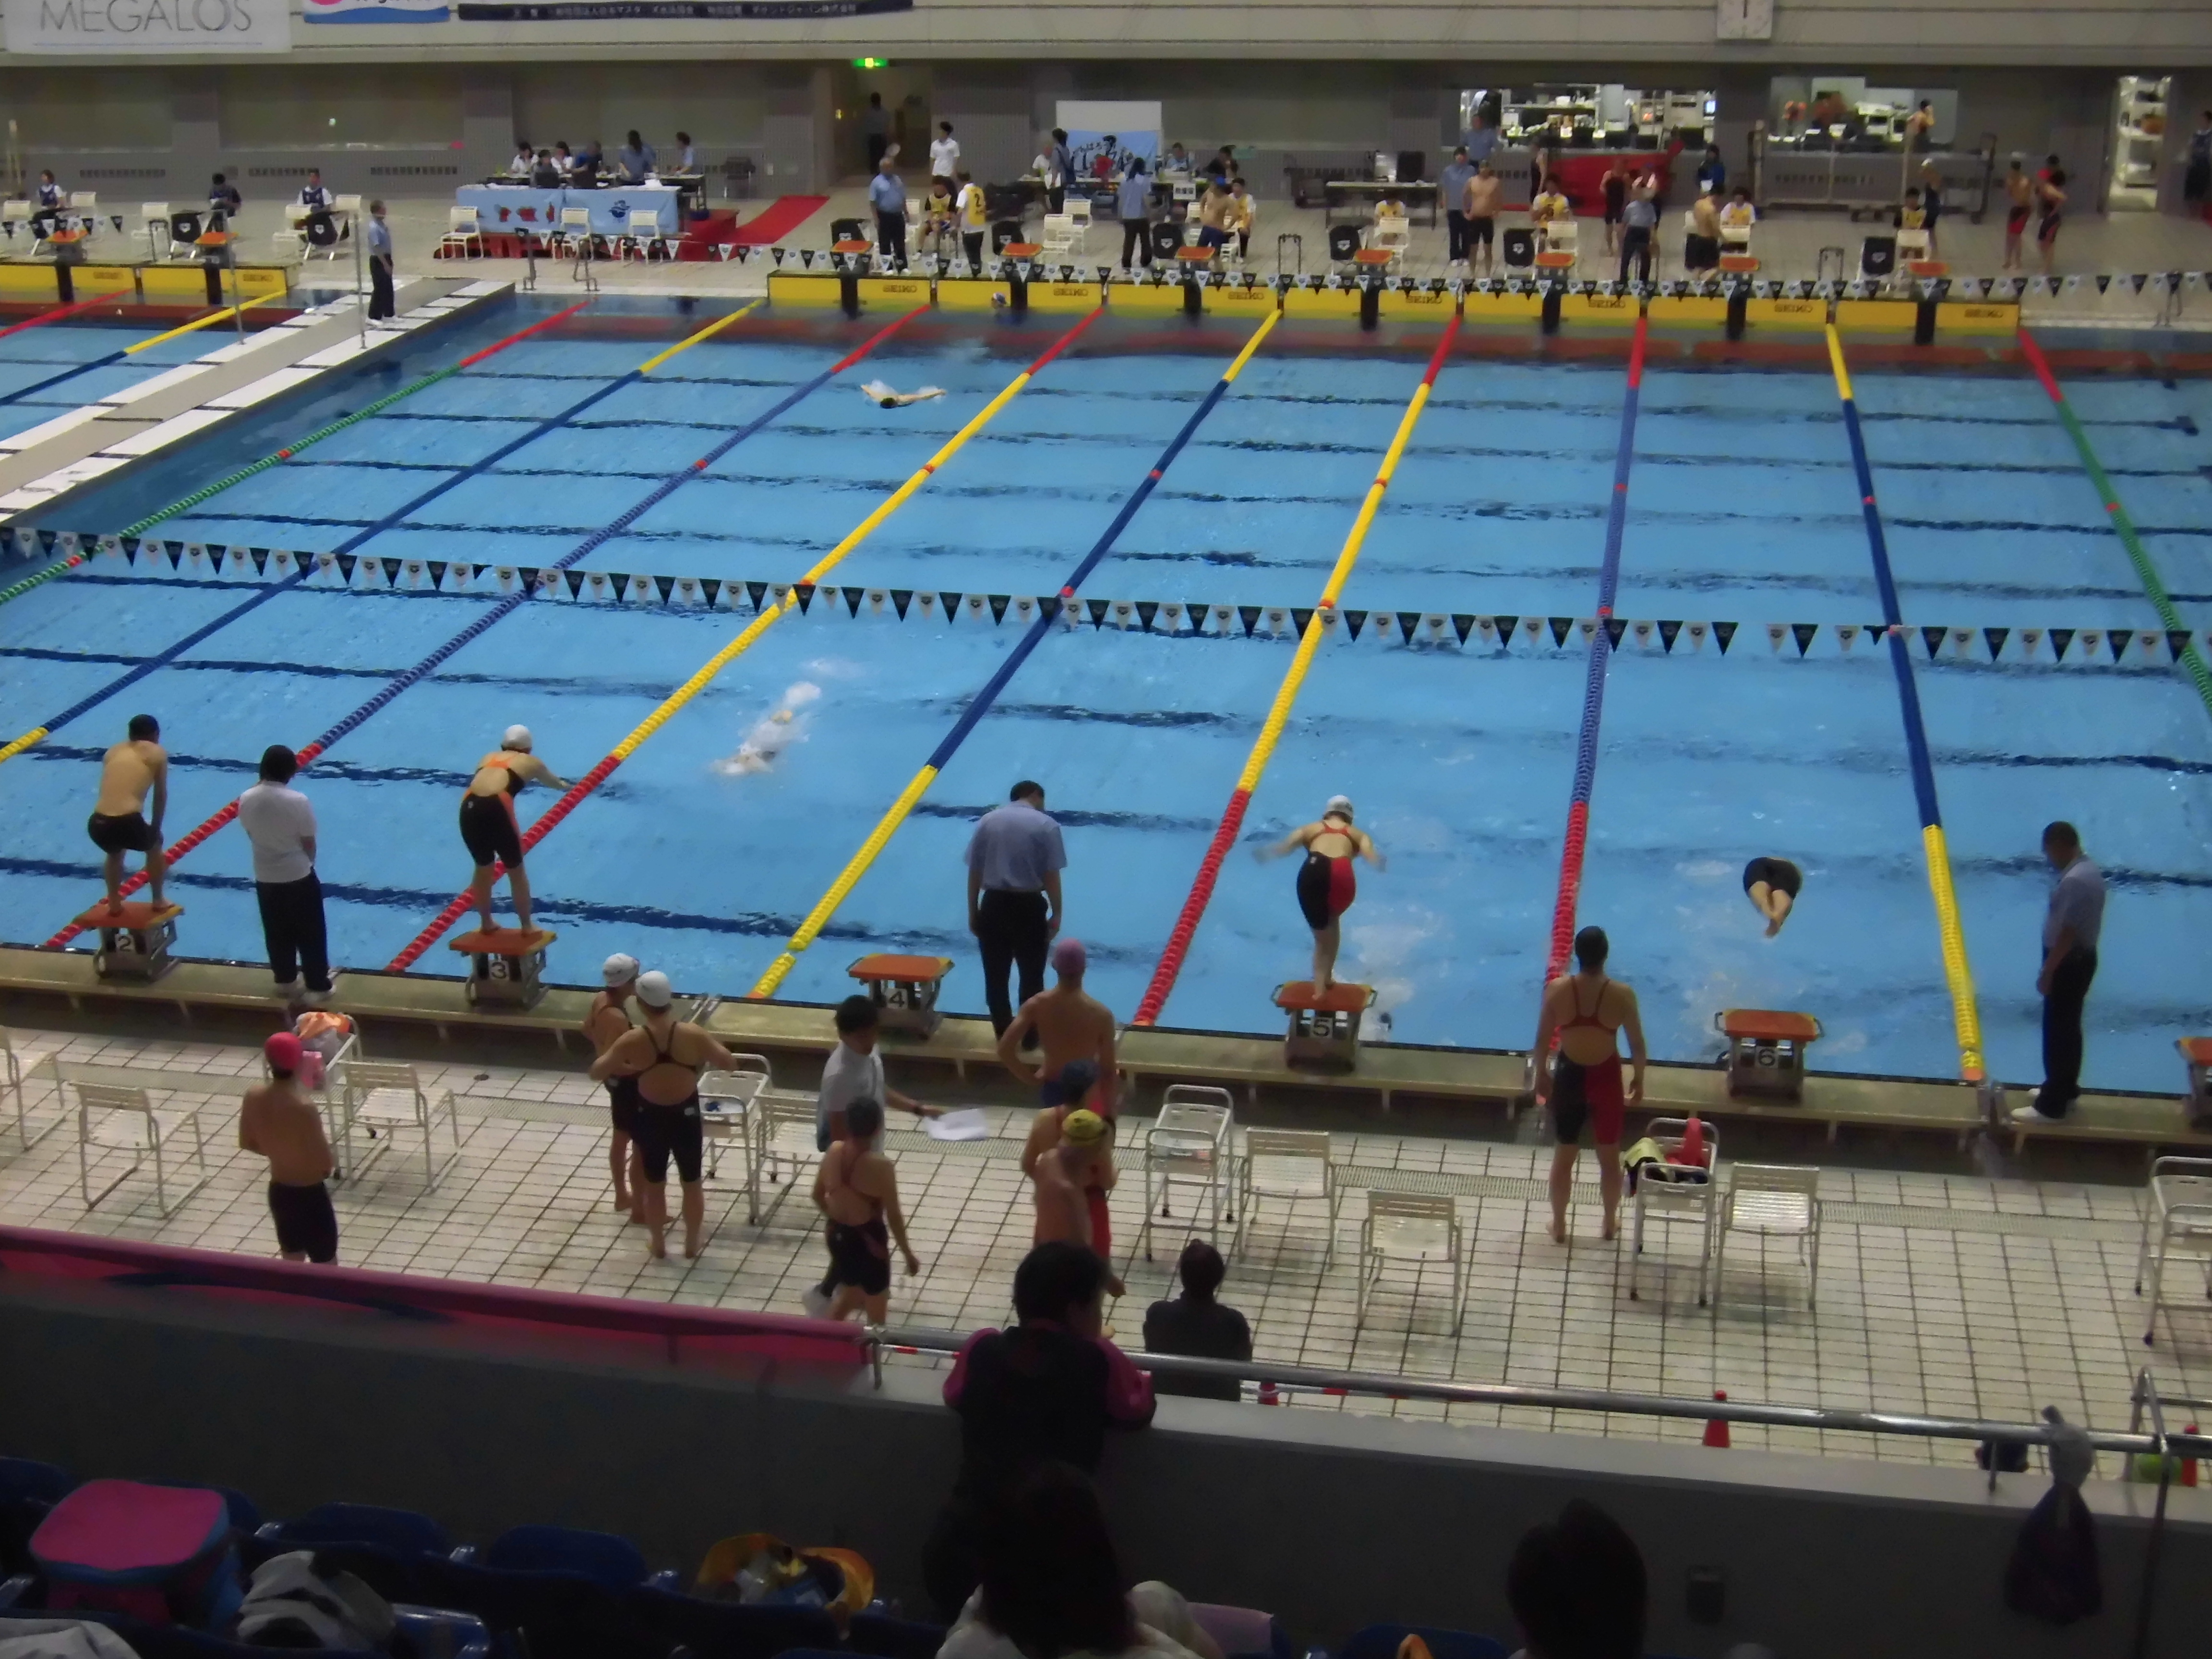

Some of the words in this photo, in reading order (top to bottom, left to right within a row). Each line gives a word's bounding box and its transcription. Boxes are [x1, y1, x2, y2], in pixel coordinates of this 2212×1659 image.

[39, 0, 252, 32] MEGALOS
[974, 193, 982, 207] 2
[882, 285, 917, 293] SEIKO
[1053, 288, 1089, 296] SEIKO
[1227, 291, 1264, 300] SEIKO
[1406, 295, 1443, 304] SEIKO
[1588, 300, 1626, 309] SEIKO
[1775, 304, 1814, 313] SEIKO
[118, 936, 132, 952] 2
[491, 962, 506, 979] 3
[889, 991, 904, 1007] 4
[1313, 1019, 1330, 1037] 5
[1758, 1048, 1775, 1067] 6
